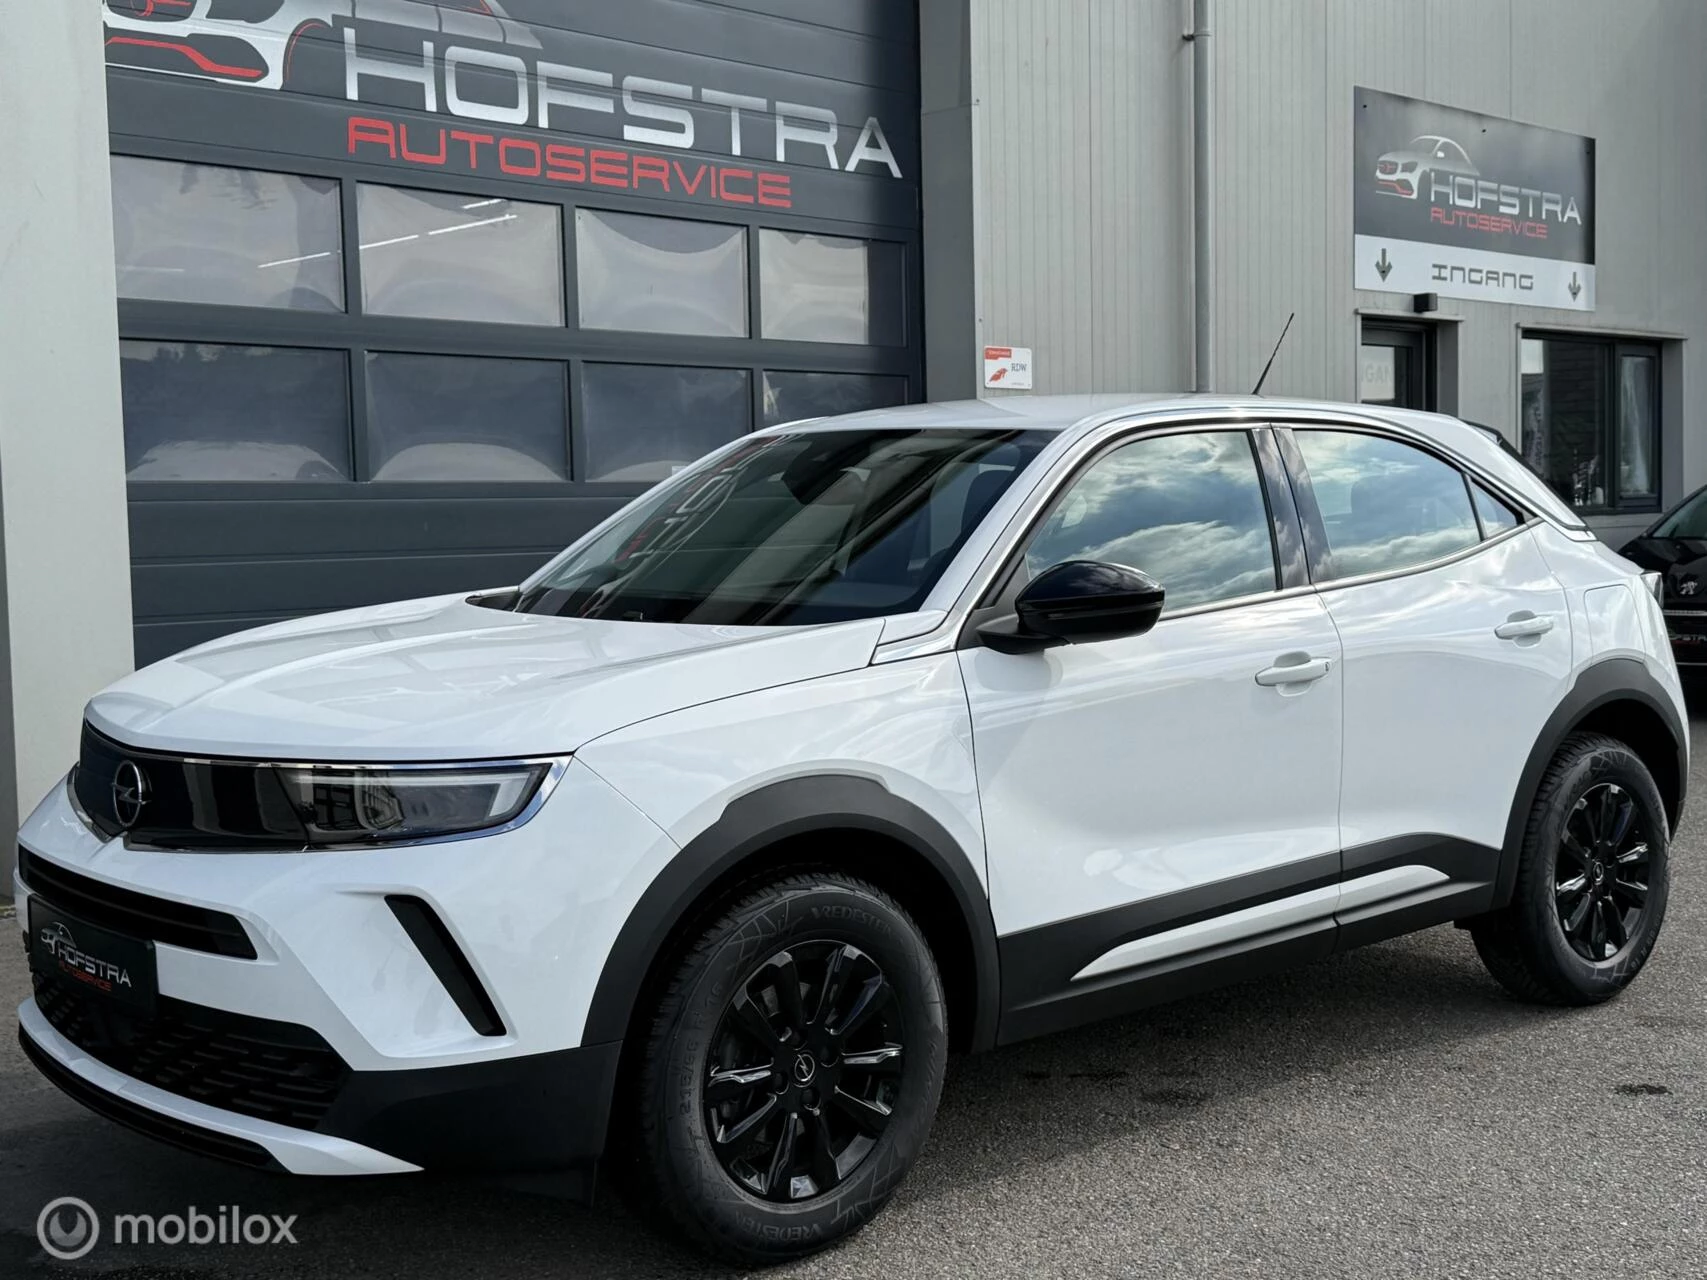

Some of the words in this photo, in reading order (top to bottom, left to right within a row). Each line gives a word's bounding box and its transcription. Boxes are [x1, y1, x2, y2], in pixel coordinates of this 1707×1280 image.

[345, 27, 904, 180] HOFSTRA
[348, 117, 792, 209] AUTOSERVICE
[1430, 171, 1582, 225] HOFSTRA
[1430, 207, 1548, 239] AUTOSERVICE
[1432, 263, 1534, 290] INGANG
[1011, 362, 1027, 372] RDW
[58, 940, 132, 988] HOFSTRA
